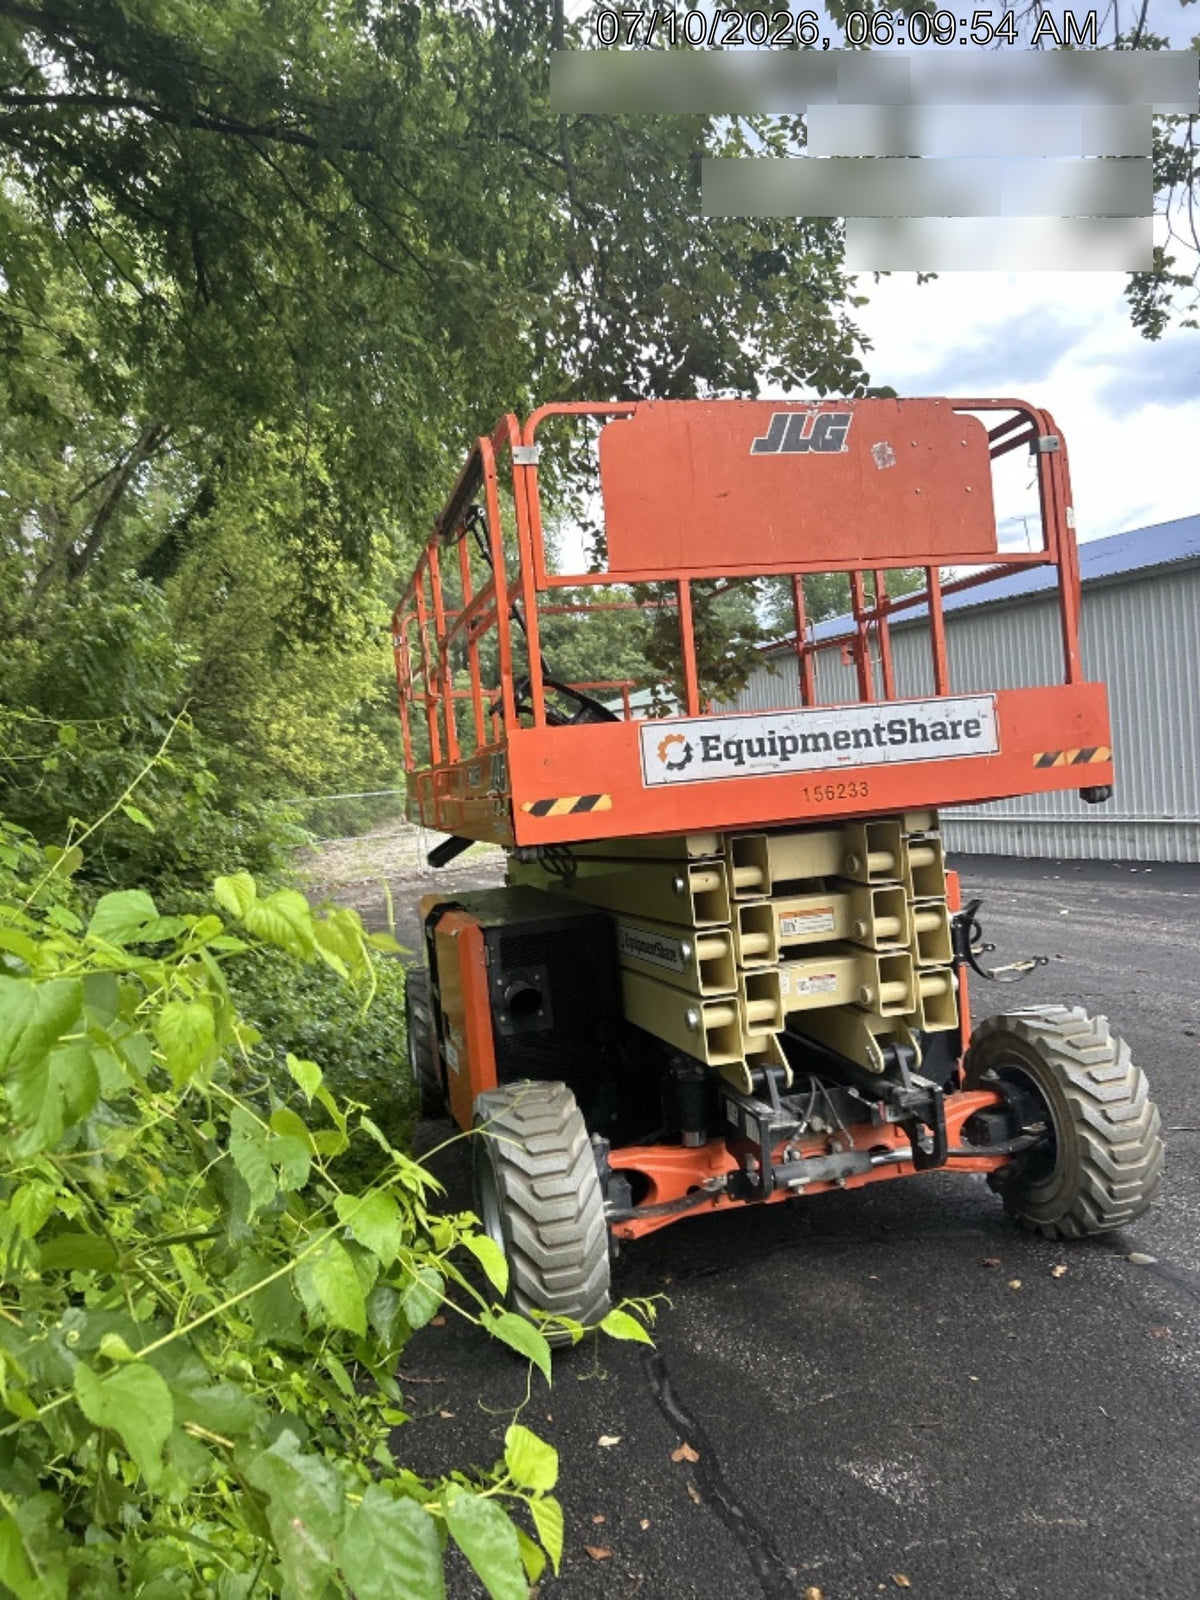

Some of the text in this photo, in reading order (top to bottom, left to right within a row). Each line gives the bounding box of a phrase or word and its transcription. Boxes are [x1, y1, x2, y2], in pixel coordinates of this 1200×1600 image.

[750, 411, 854, 455] JLG
[700, 717, 982, 766] EquipmentShare
[803, 781, 869, 802] 156233
